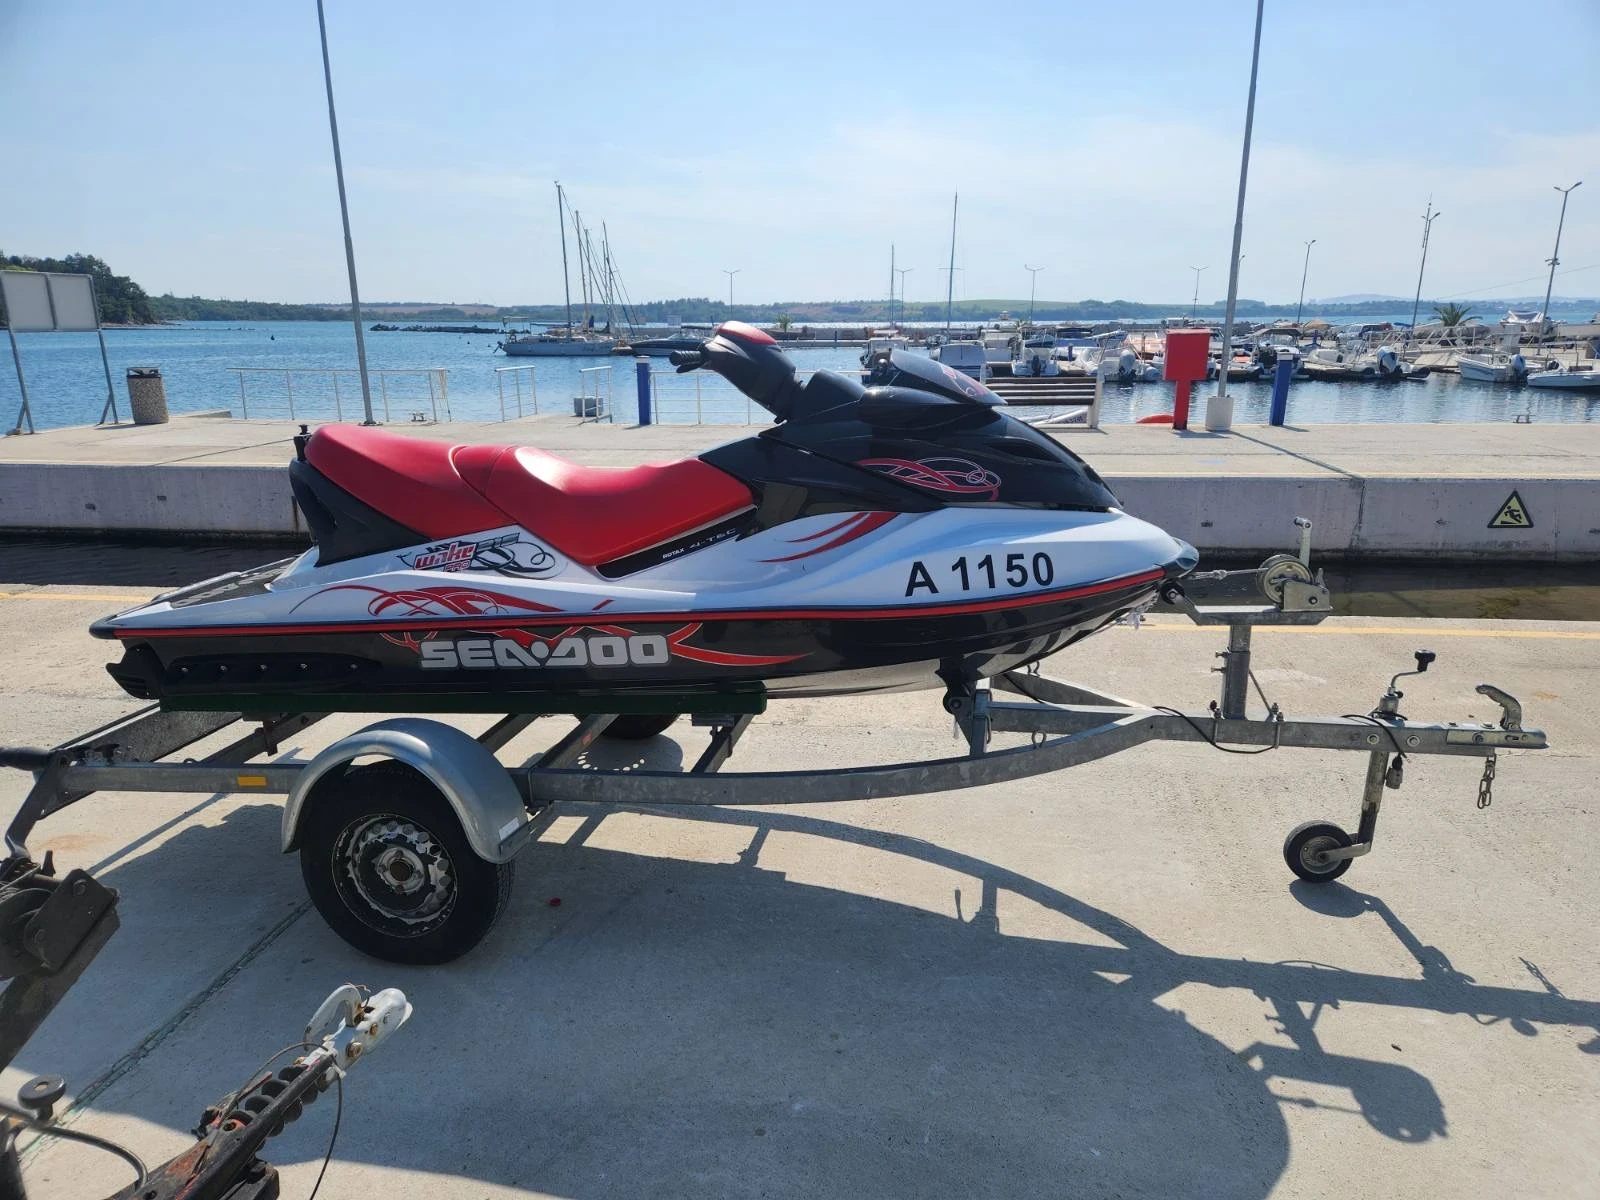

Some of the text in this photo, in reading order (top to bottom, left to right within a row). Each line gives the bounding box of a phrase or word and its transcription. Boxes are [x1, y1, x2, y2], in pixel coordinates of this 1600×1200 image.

[662, 548, 685, 559] ROTAX
[905, 552, 1054, 597] A 1150
